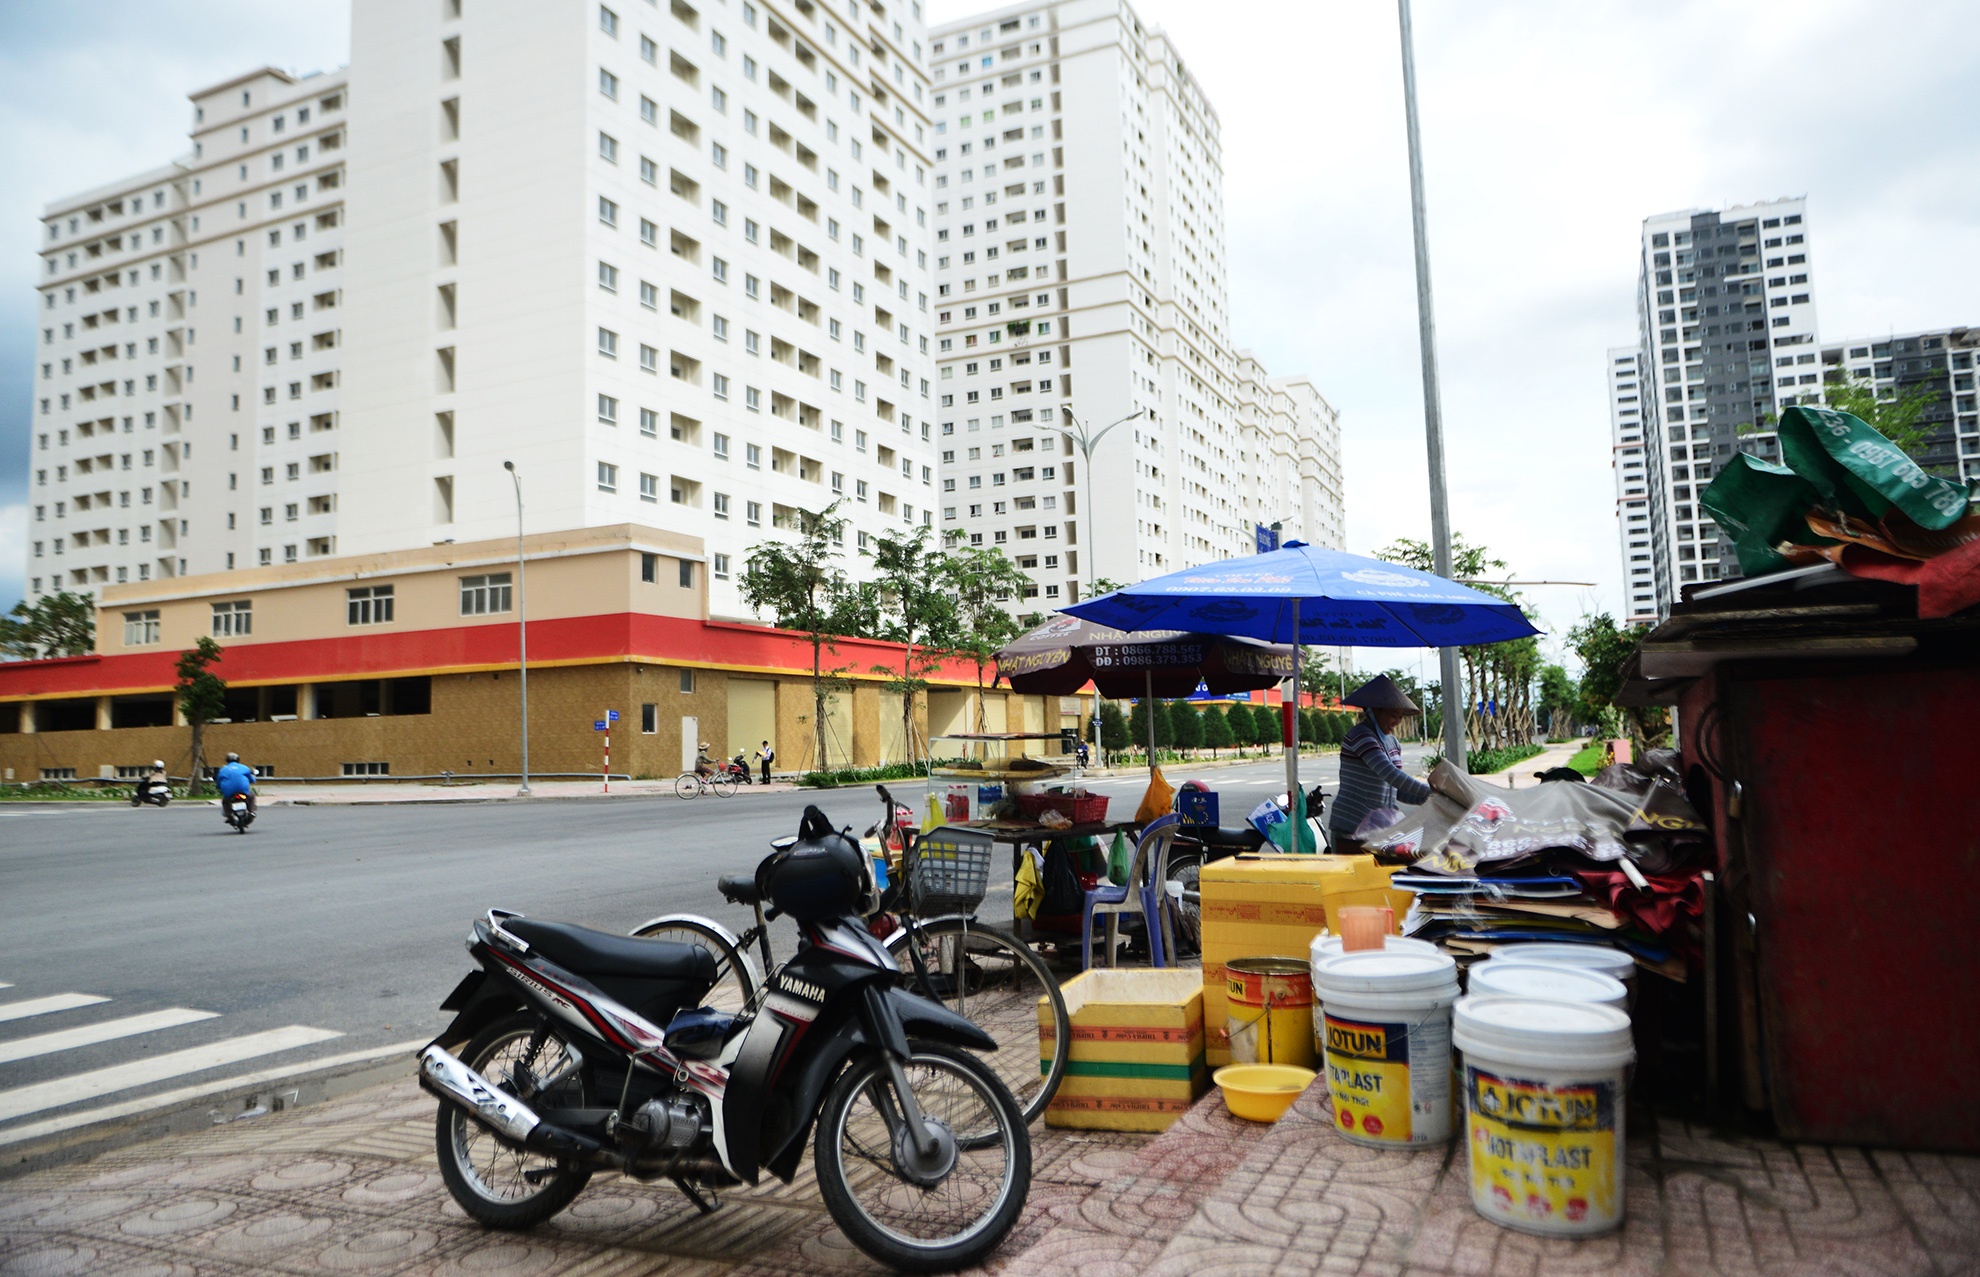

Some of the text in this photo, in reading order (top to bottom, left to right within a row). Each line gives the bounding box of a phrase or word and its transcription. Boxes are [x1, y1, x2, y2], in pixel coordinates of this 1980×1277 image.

[1818, 411, 1851, 437] 236
[1848, 441, 1904, 470] 0987
[1029, 631, 1073, 641] COFFEE
[506, 966, 553, 998] SIRIUS
[779, 974, 826, 1003] YAMAHA
[1328, 1025, 1383, 1053] JOTUN
